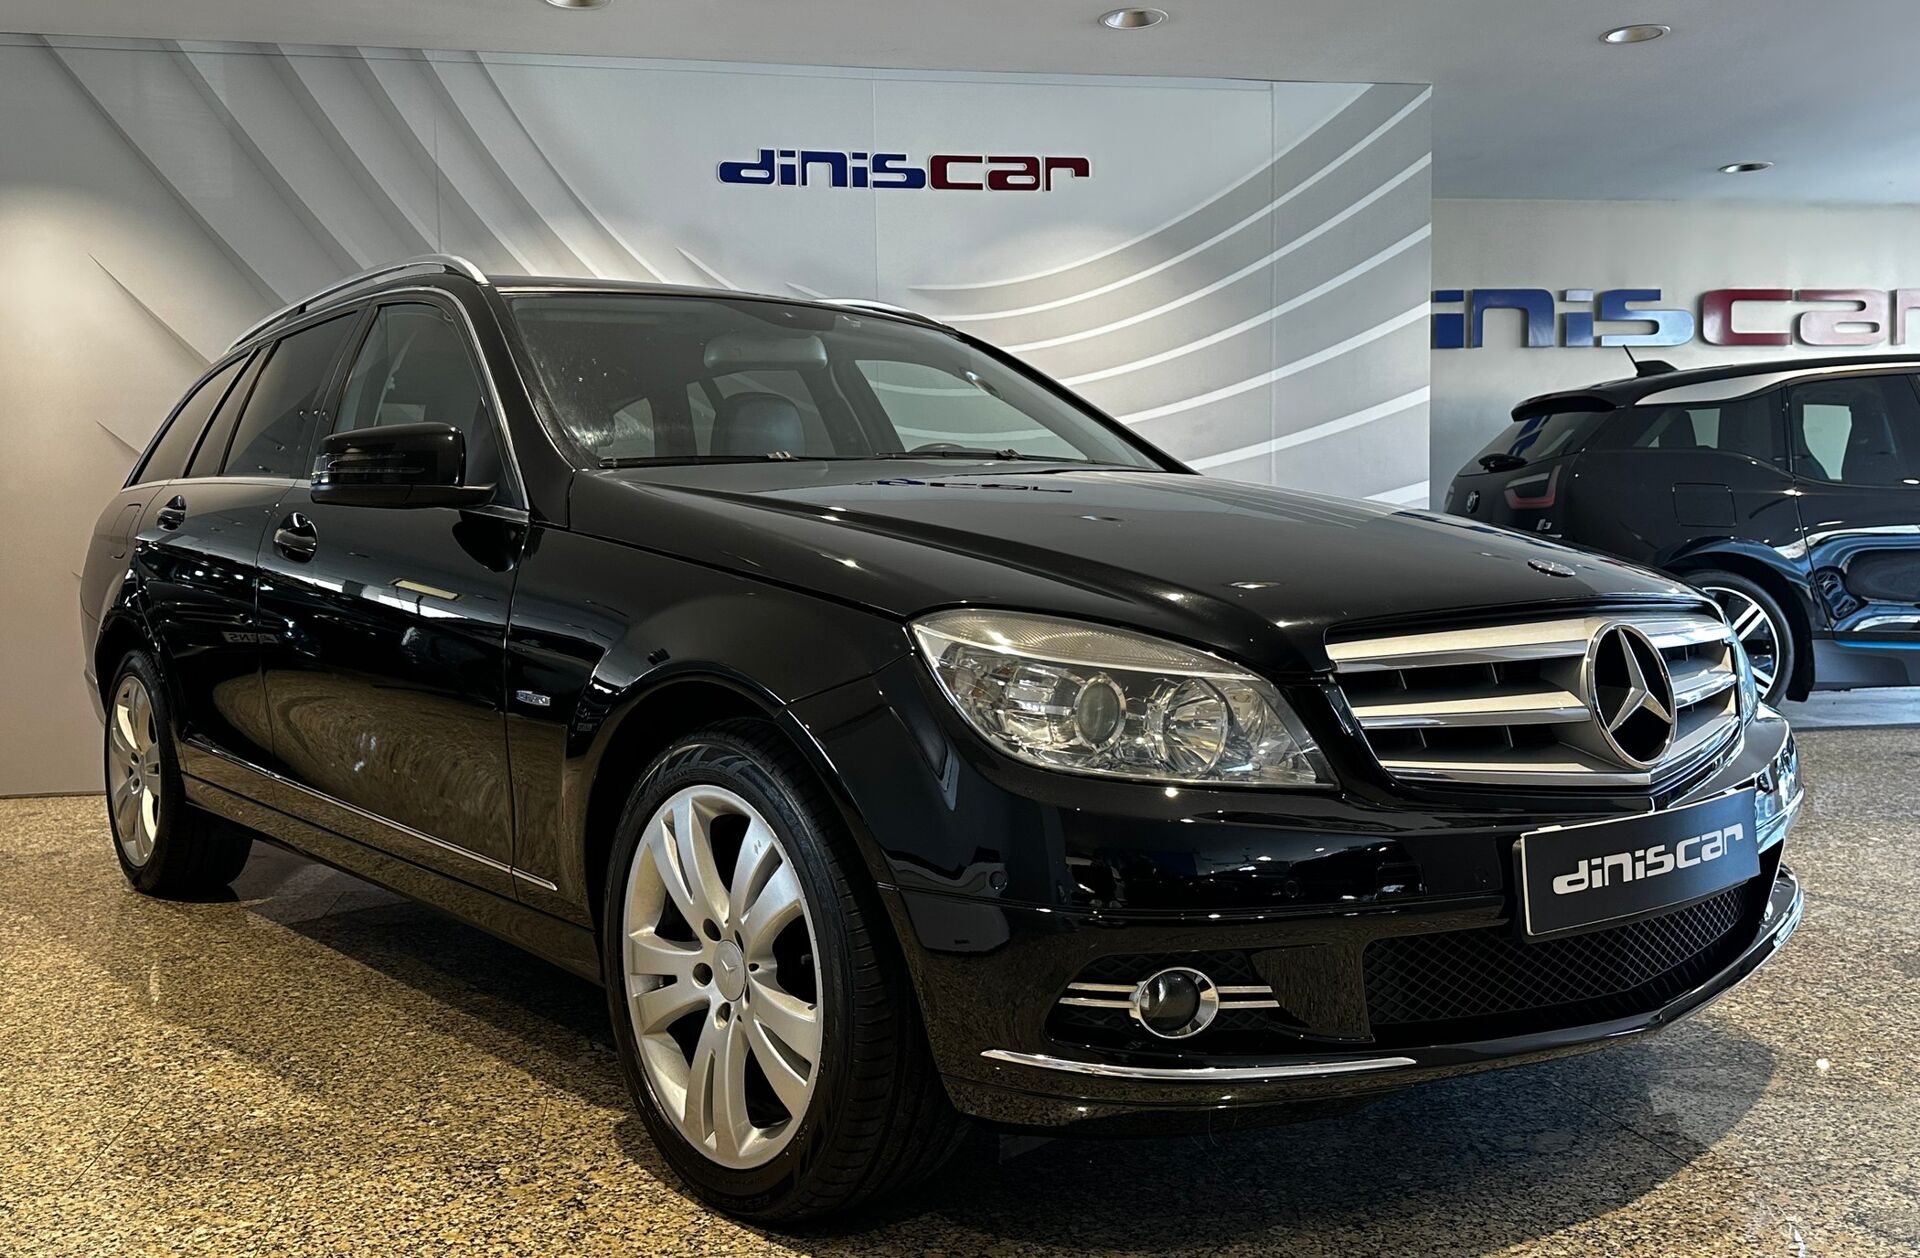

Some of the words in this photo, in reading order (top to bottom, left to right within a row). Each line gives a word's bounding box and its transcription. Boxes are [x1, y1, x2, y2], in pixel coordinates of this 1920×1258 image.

[717, 148, 1091, 192] diniscar
[1431, 288, 1920, 348] inisca
[1552, 823, 1744, 895] diniscar
